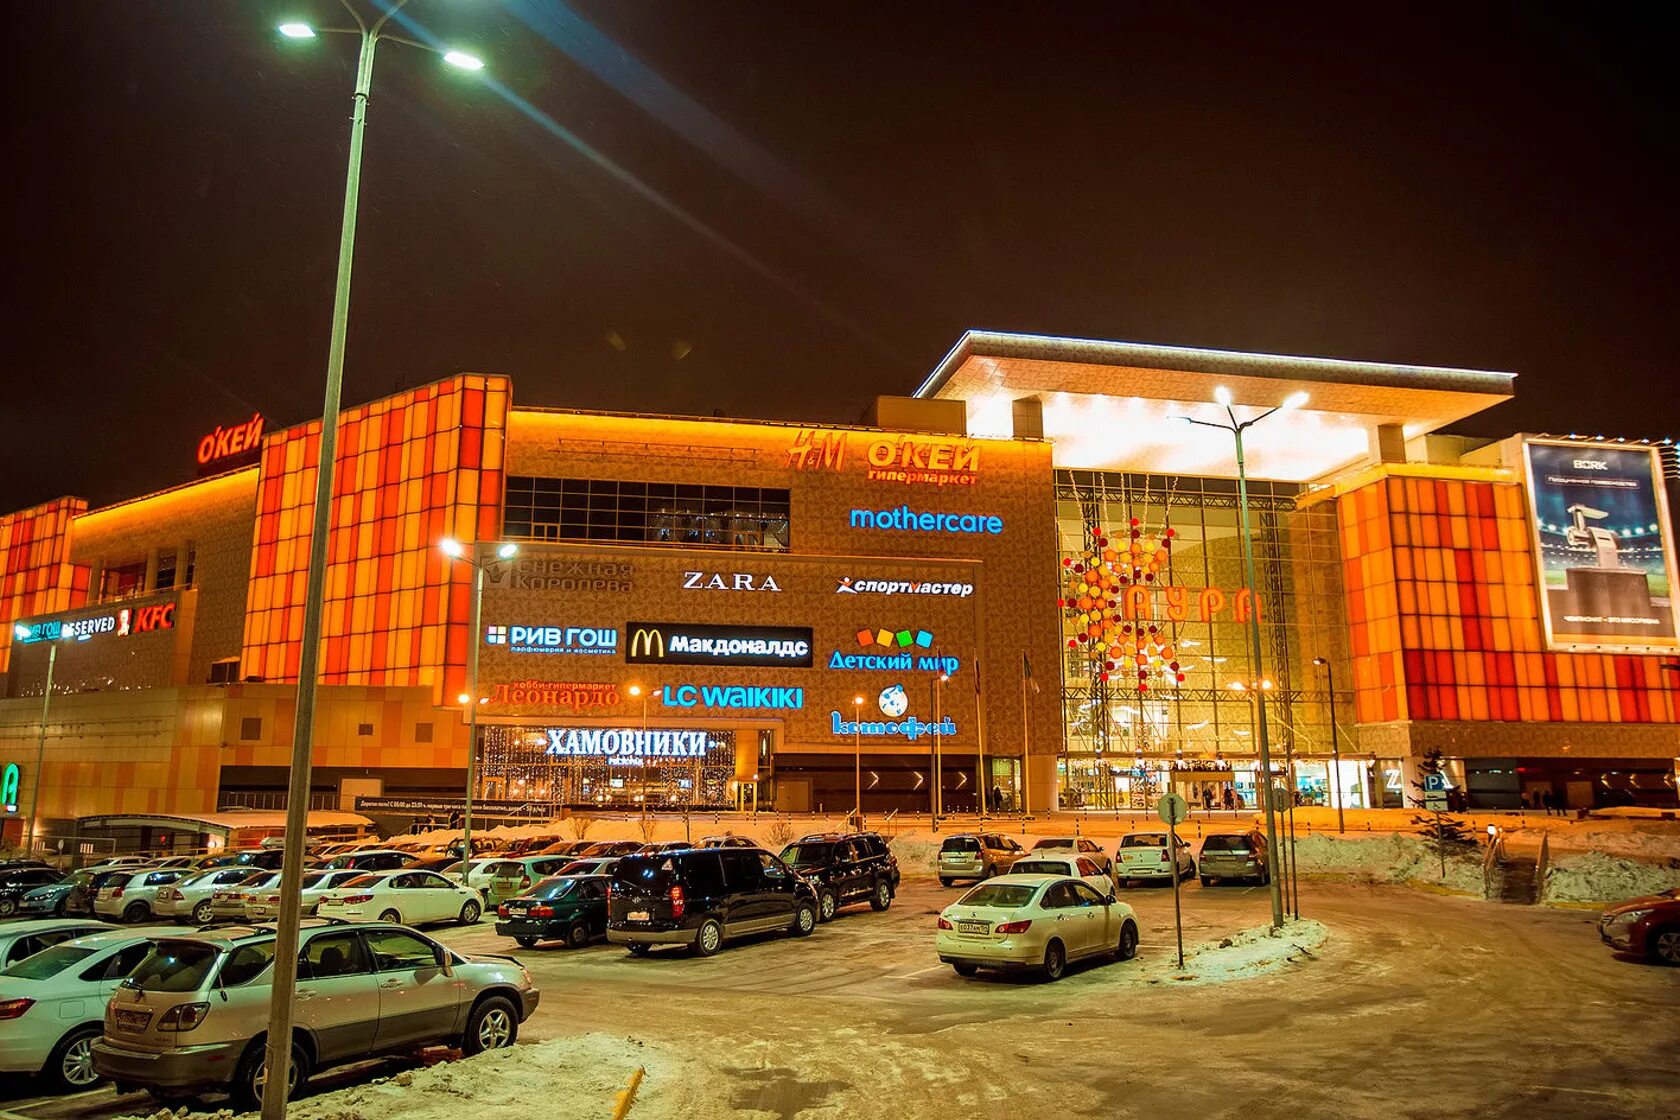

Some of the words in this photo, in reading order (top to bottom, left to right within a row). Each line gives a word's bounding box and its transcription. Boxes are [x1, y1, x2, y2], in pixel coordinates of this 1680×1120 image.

[785, 430, 848, 472] H&M
[867, 469, 978, 486] гипермаркет
[1573, 459, 1609, 470] BORK
[850, 504, 1004, 534] mothercare
[682, 571, 783, 592] ZARA
[854, 579, 974, 597] спортмастер
[1125, 584, 1263, 624] АУРА
[134, 602, 177, 633] KFC
[509, 626, 562, 645] РИВ
[565, 628, 618, 647] ГОШ
[669, 636, 809, 658] Макдоналдс
[828, 650, 913, 670] Детский
[917, 656, 960, 676] мир
[489, 683, 620, 711] Леонардо
[663, 685, 698, 708] LC
[831, 711, 957, 740] котофей
[545, 729, 708, 756] ХАМОВНИКИ
